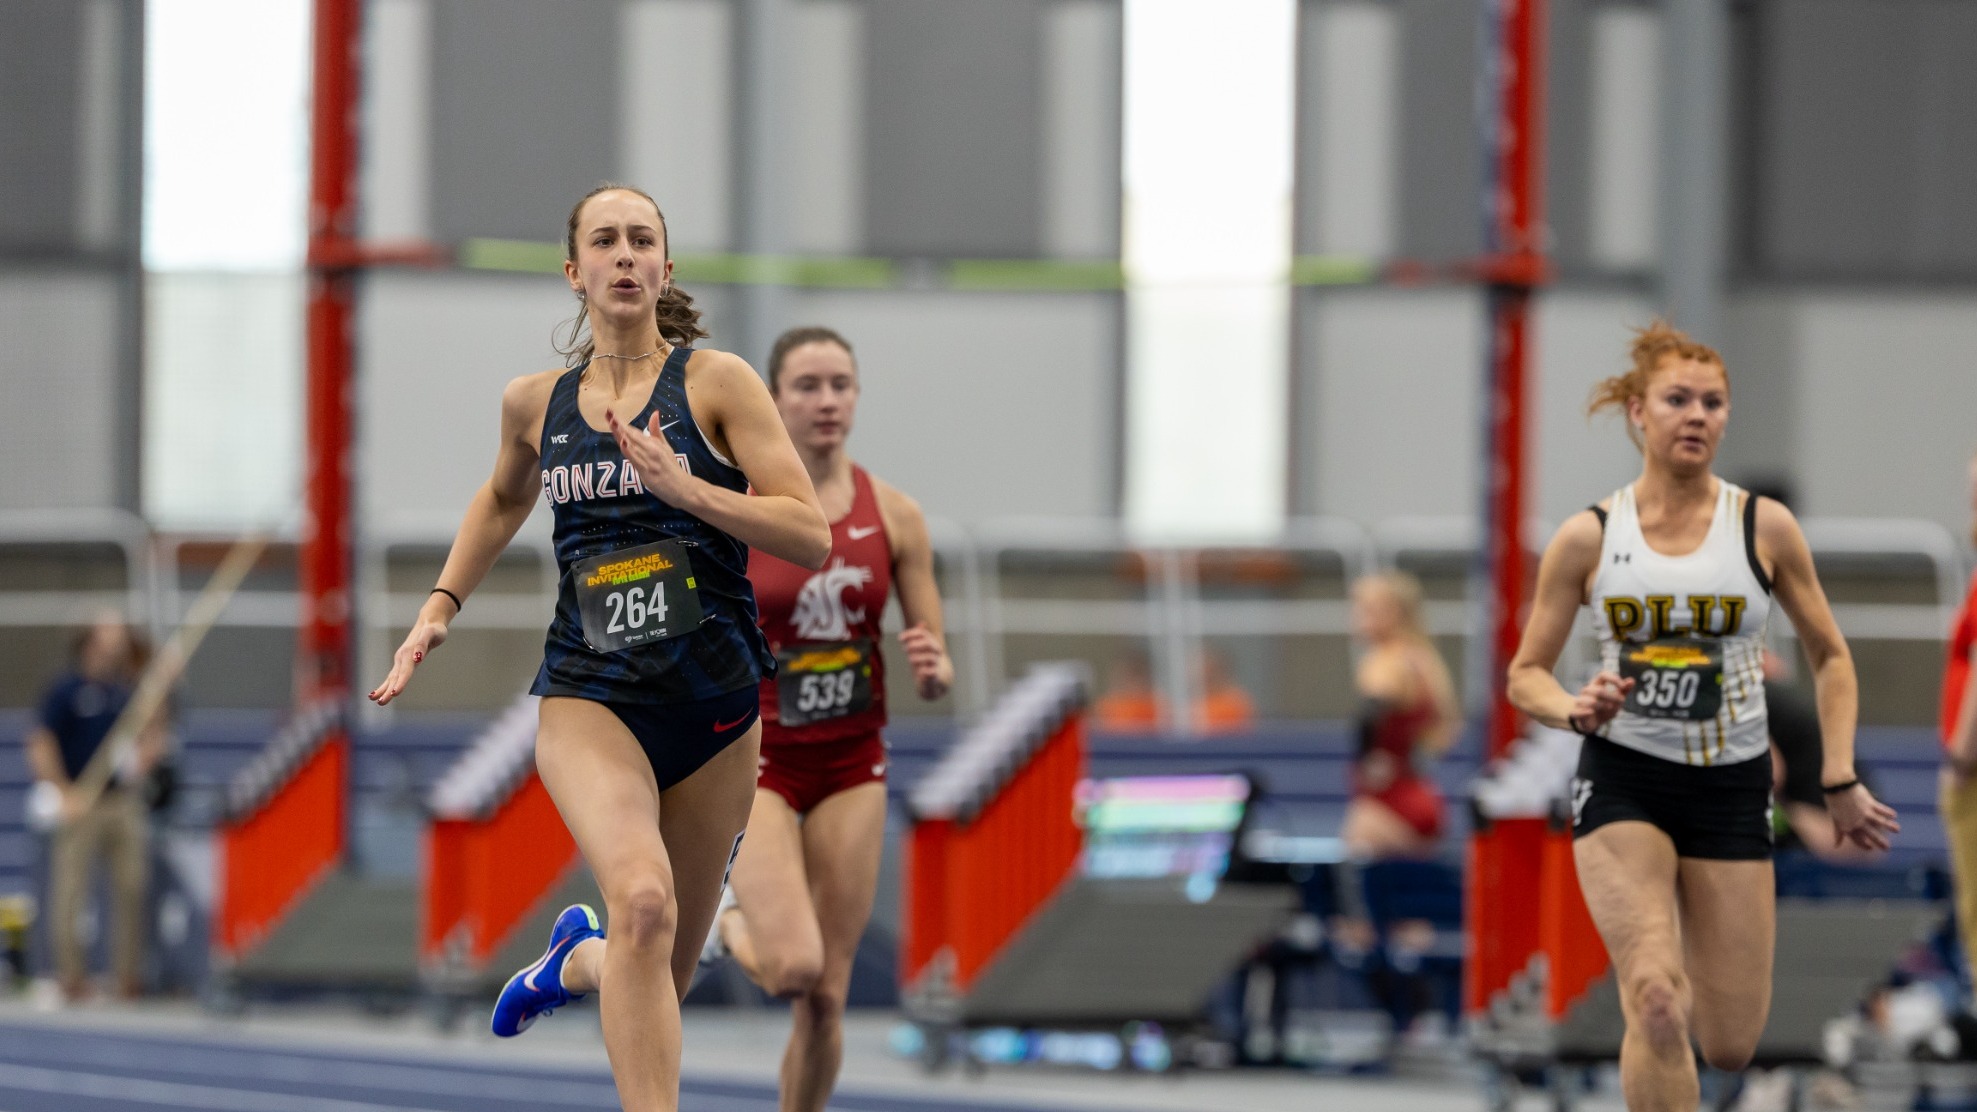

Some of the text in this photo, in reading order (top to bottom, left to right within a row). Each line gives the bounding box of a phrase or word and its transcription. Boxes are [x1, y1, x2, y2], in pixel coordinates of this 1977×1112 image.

[551, 434, 569, 444] WCC
[541, 453, 692, 507] GONZAA
[587, 560, 674, 587] INVITATIONAL
[598, 553, 661, 576] SPOKANE
[605, 581, 669, 635] 264
[1604, 595, 1747, 643] PLU
[797, 669, 856, 713] 539
[1636, 669, 1701, 709] 350
